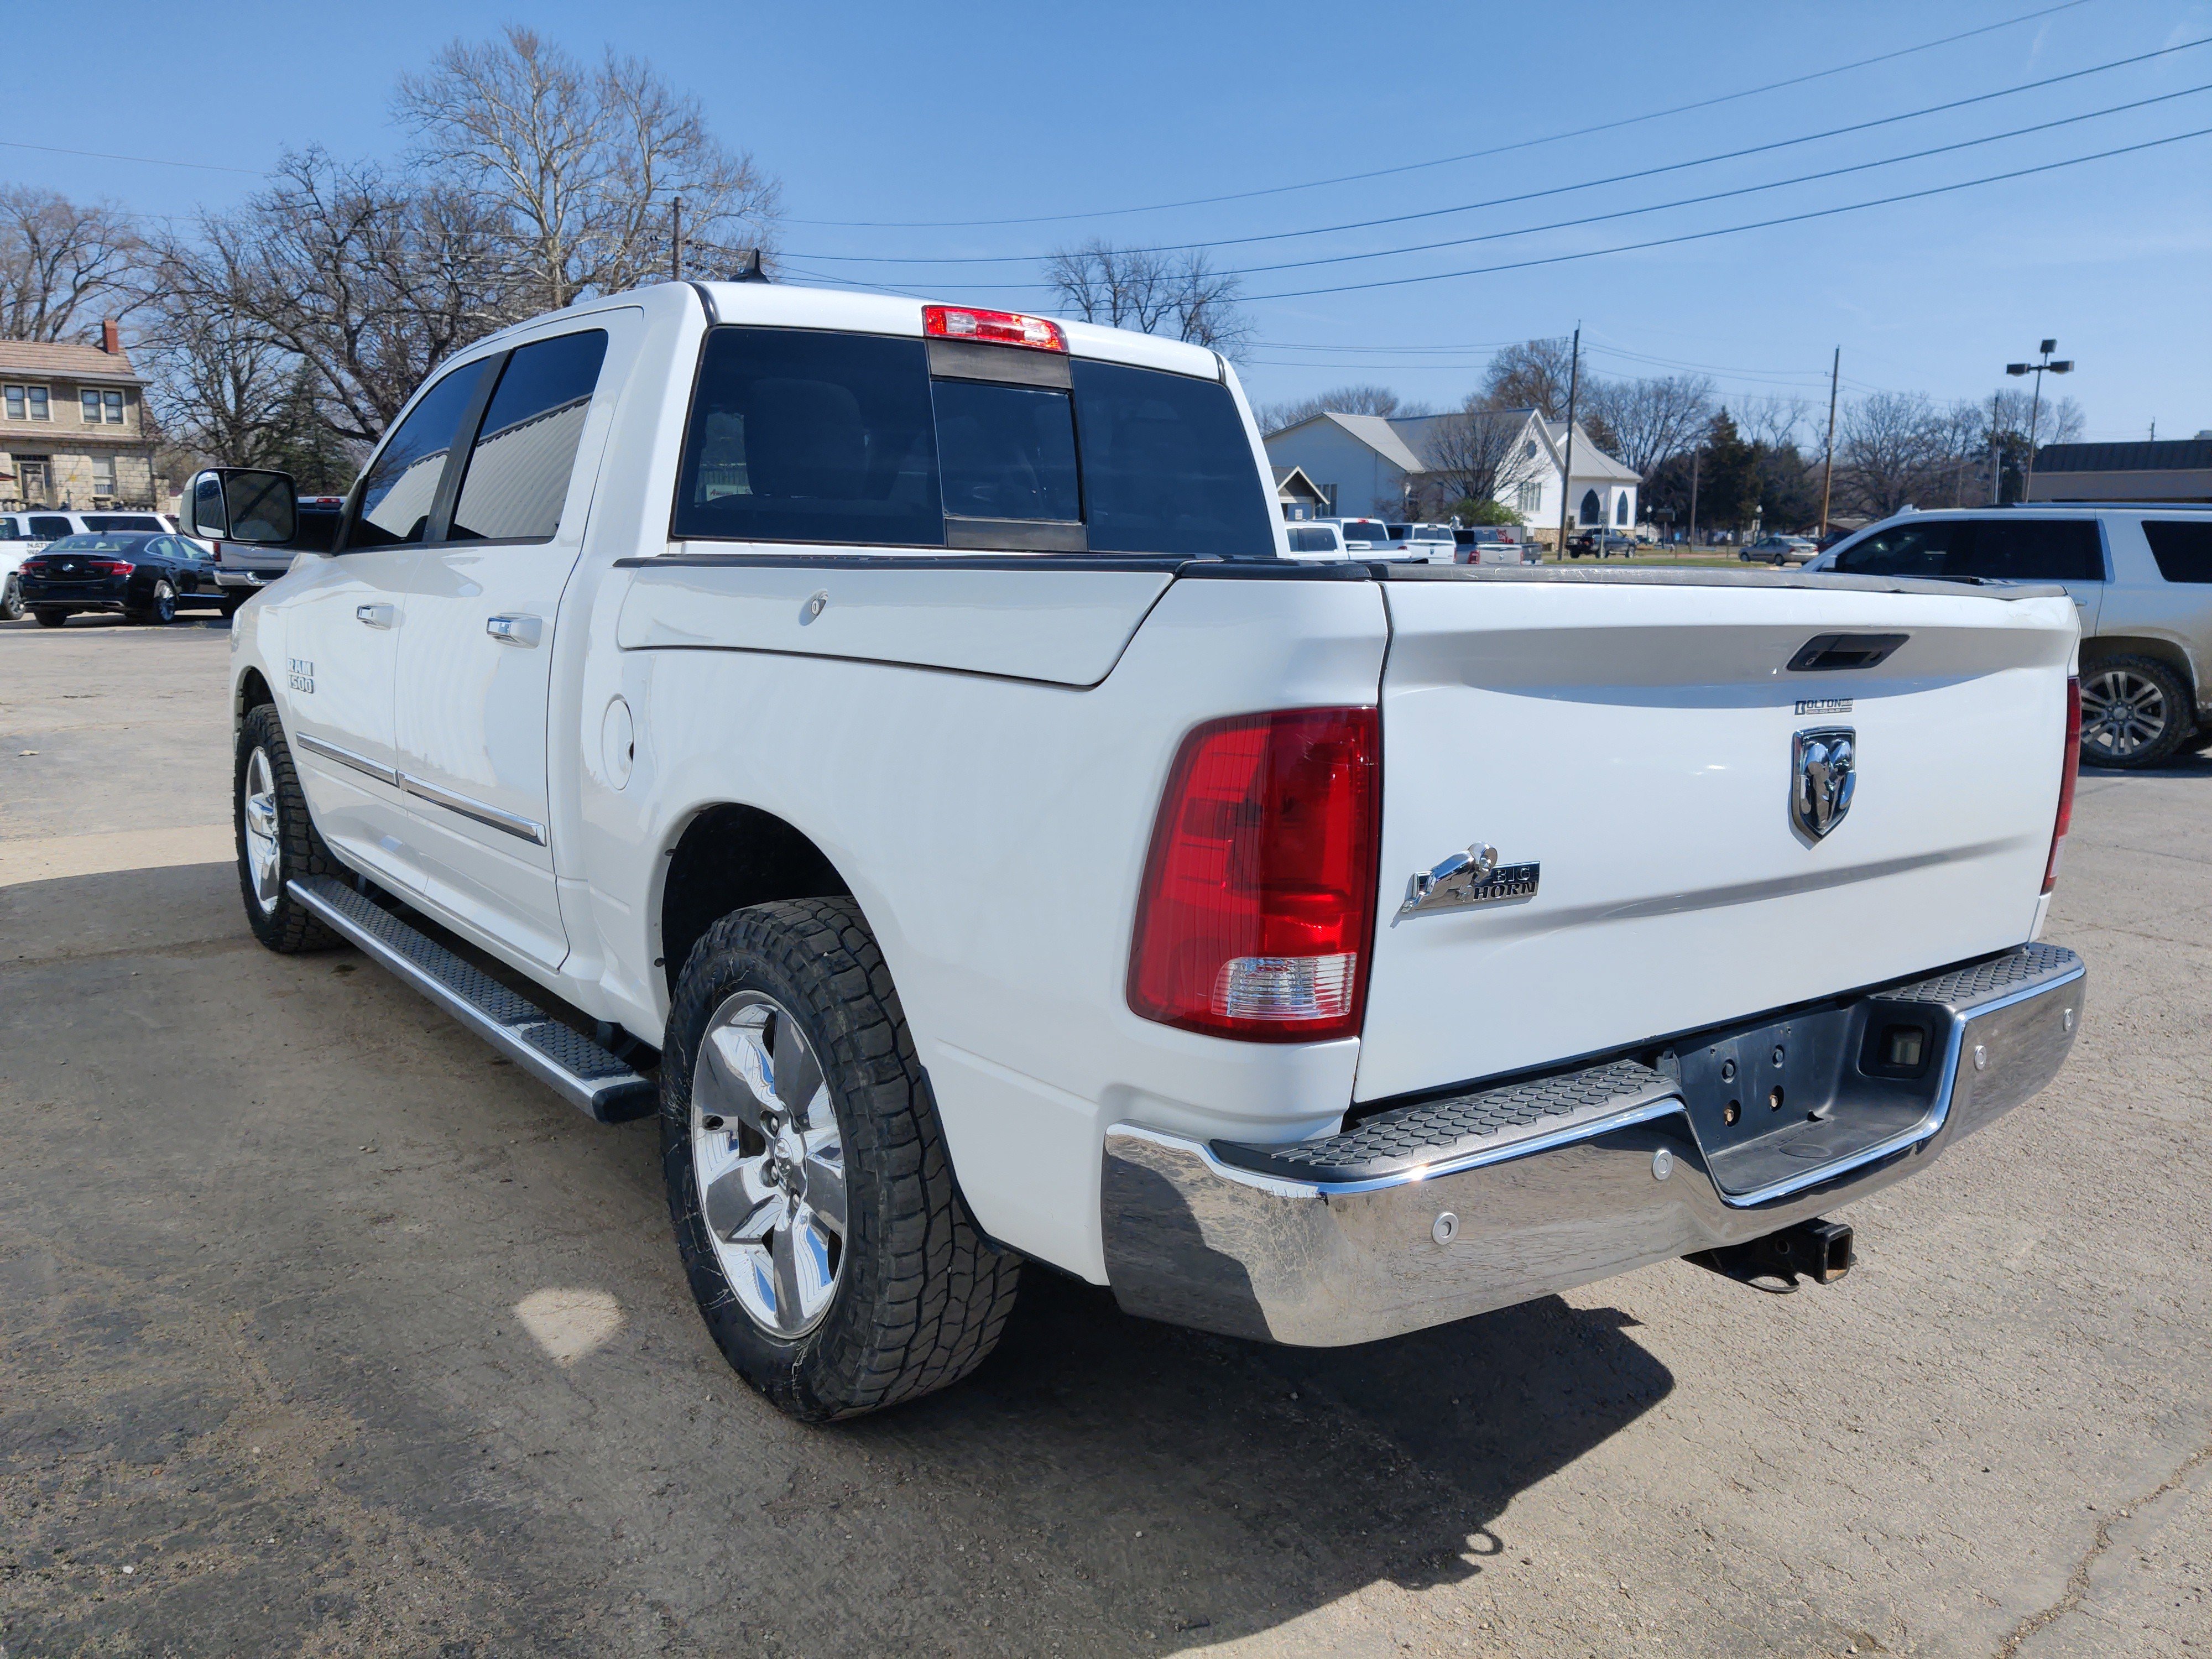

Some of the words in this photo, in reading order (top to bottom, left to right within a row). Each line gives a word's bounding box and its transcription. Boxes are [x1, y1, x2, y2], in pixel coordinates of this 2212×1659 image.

[288, 658, 314, 676] RAM
[288, 675, 314, 694] 1500
[1493, 866, 1530, 883] BIG
[1473, 881, 1537, 901] HORN
